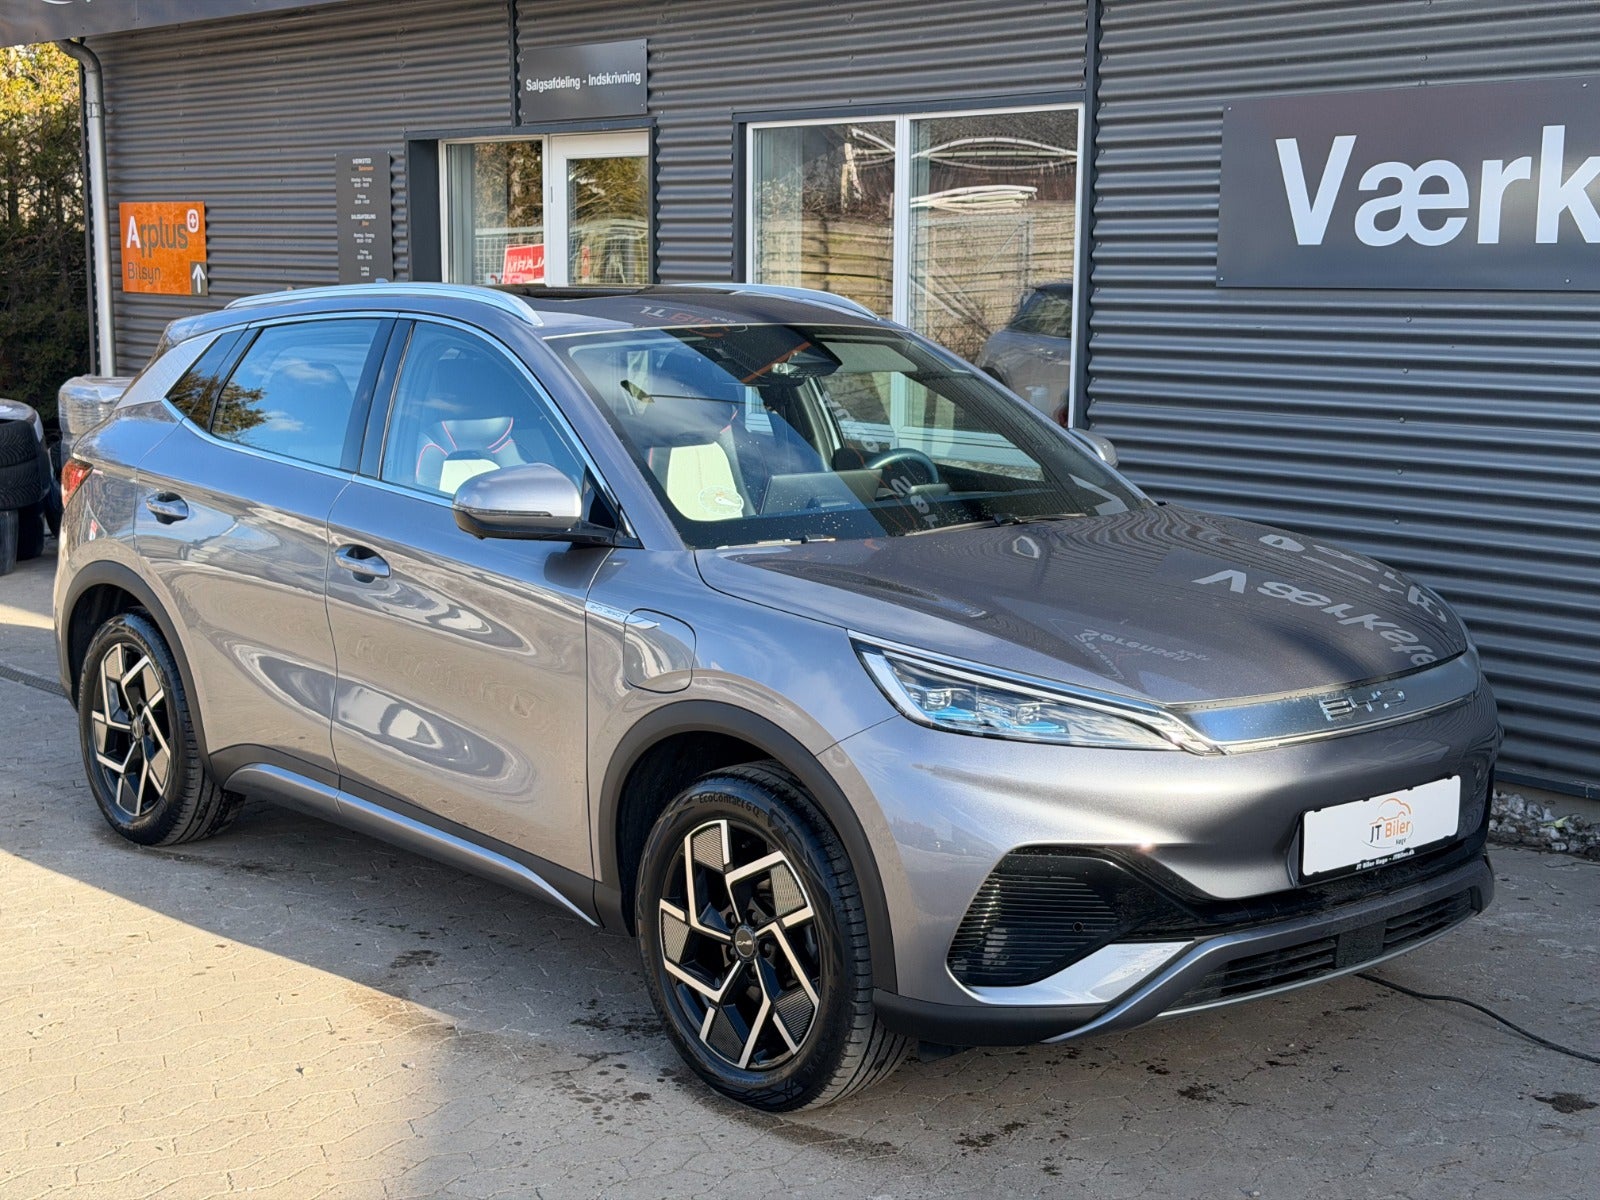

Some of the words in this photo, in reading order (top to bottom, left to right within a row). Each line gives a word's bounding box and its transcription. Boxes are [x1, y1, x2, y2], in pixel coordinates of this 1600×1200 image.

[526, 75, 581, 93] Salgsafdeling
[588, 70, 641, 87] Indskrivning
[1275, 124, 1600, 247] Værk
[127, 261, 161, 285] Bilsyn
[1370, 824, 1382, 843] JT
[1385, 820, 1411, 838] Biler
